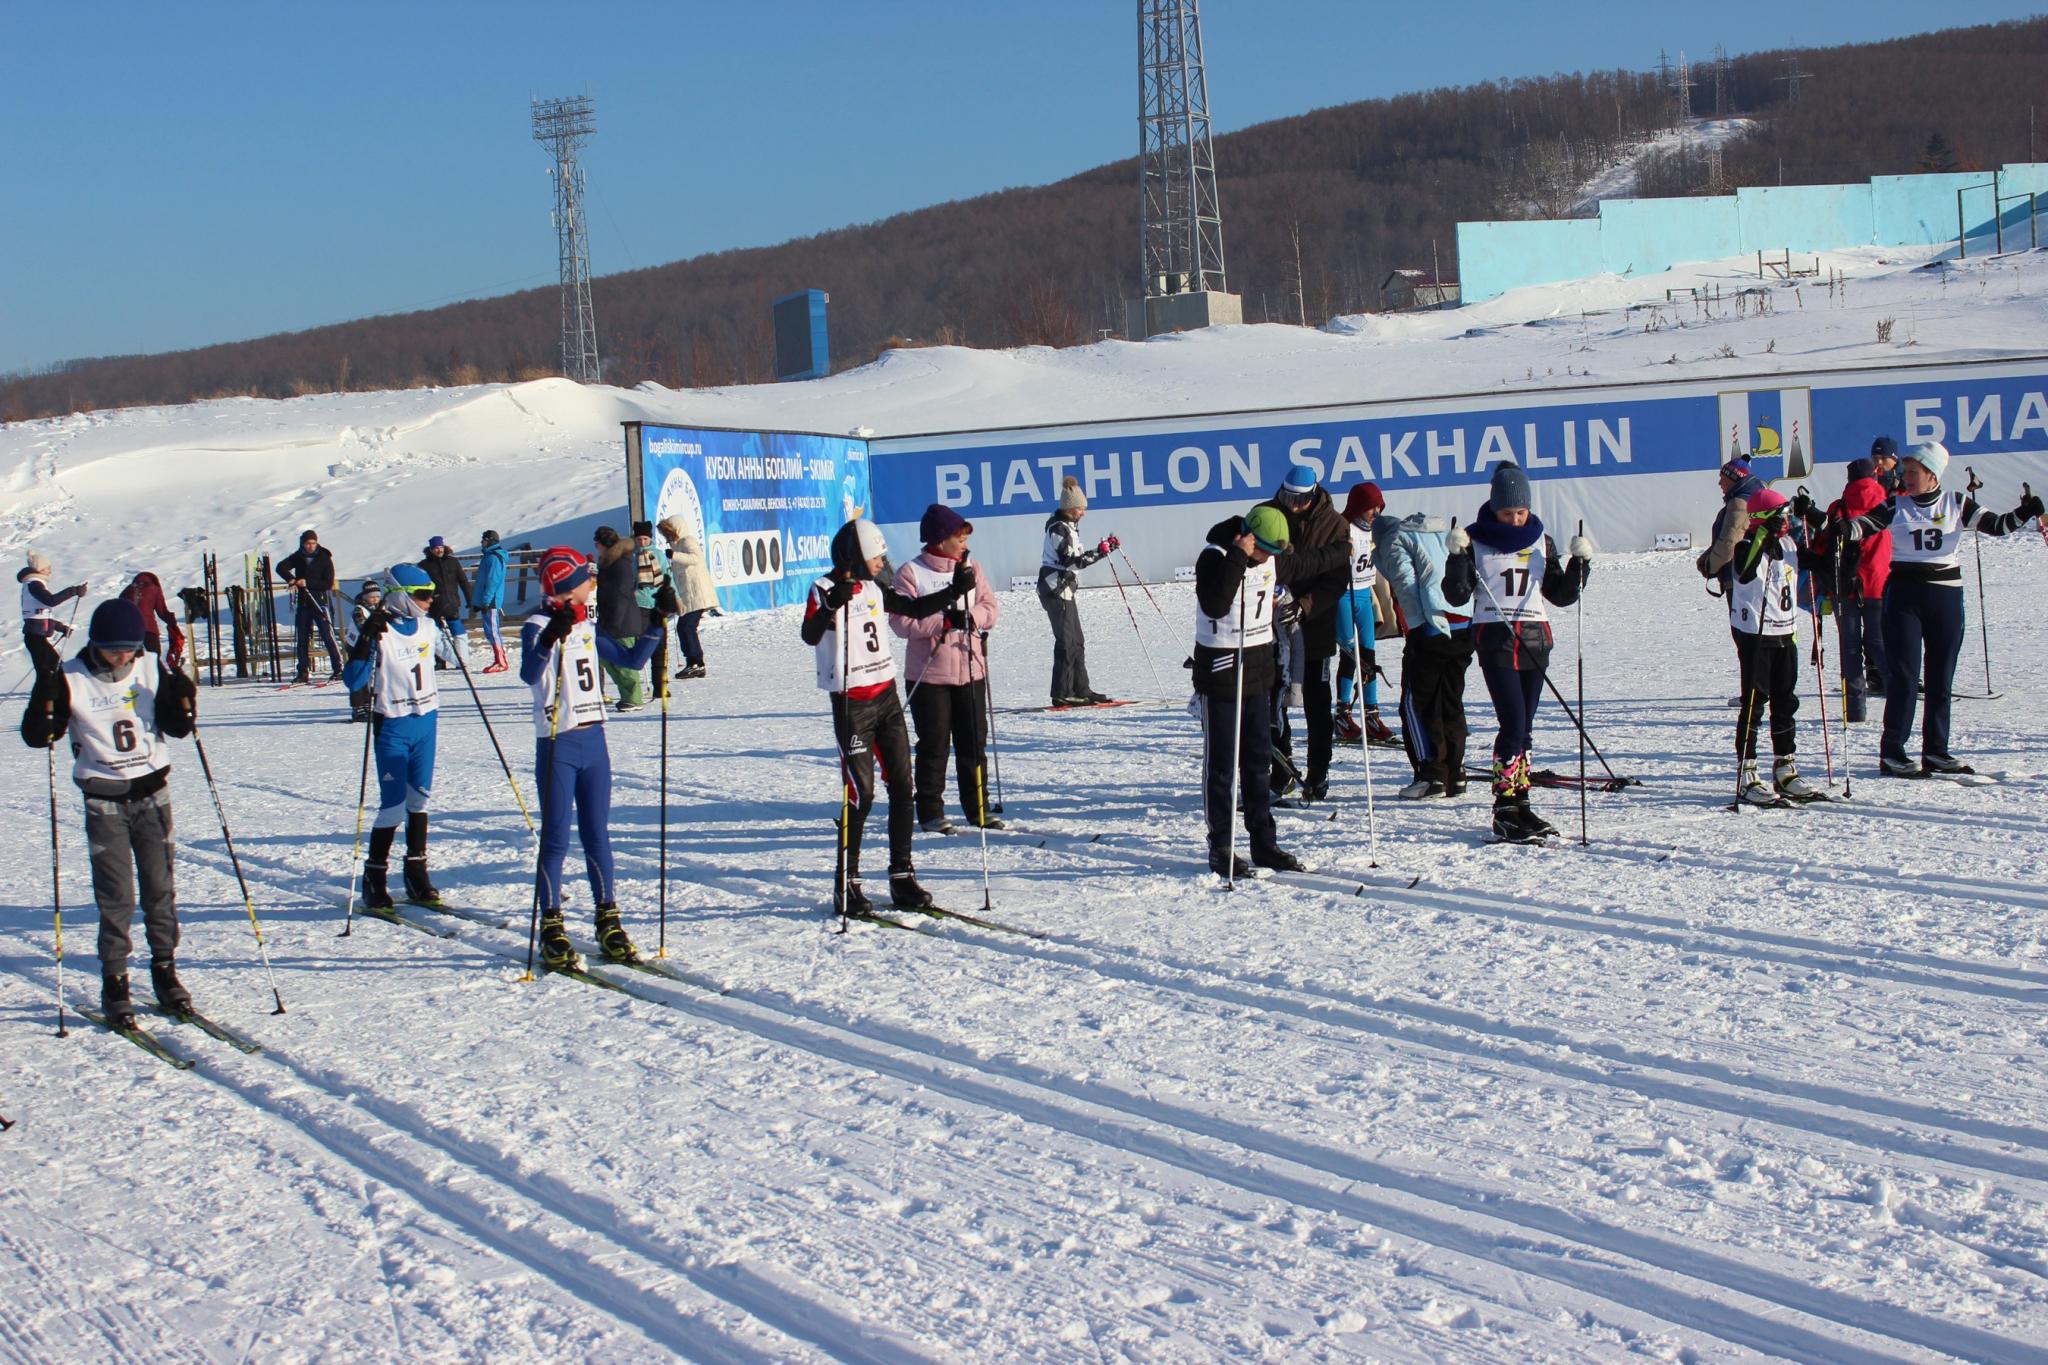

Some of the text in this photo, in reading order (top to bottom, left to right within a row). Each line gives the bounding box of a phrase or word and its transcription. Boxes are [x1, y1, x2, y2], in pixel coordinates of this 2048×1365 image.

[1905, 392, 2048, 446] БИА
[705, 456, 737, 480] КУБОК
[738, 457, 764, 480] АННЫ
[765, 452, 803, 480] БОГАЛИЙ
[936, 417, 1632, 508] BIATHLON SAKHALIN
[1909, 528, 1943, 551] 13
[1356, 554, 1373, 573] 54
[1500, 568, 1529, 597] 17
[1256, 590, 1266, 619] 7
[1780, 585, 1792, 612] 8
[1741, 608, 1748, 621] 8
[863, 621, 880, 653] 3
[410, 663, 422, 691] 1
[575, 658, 594, 692] 5
[113, 719, 137, 753] 6
